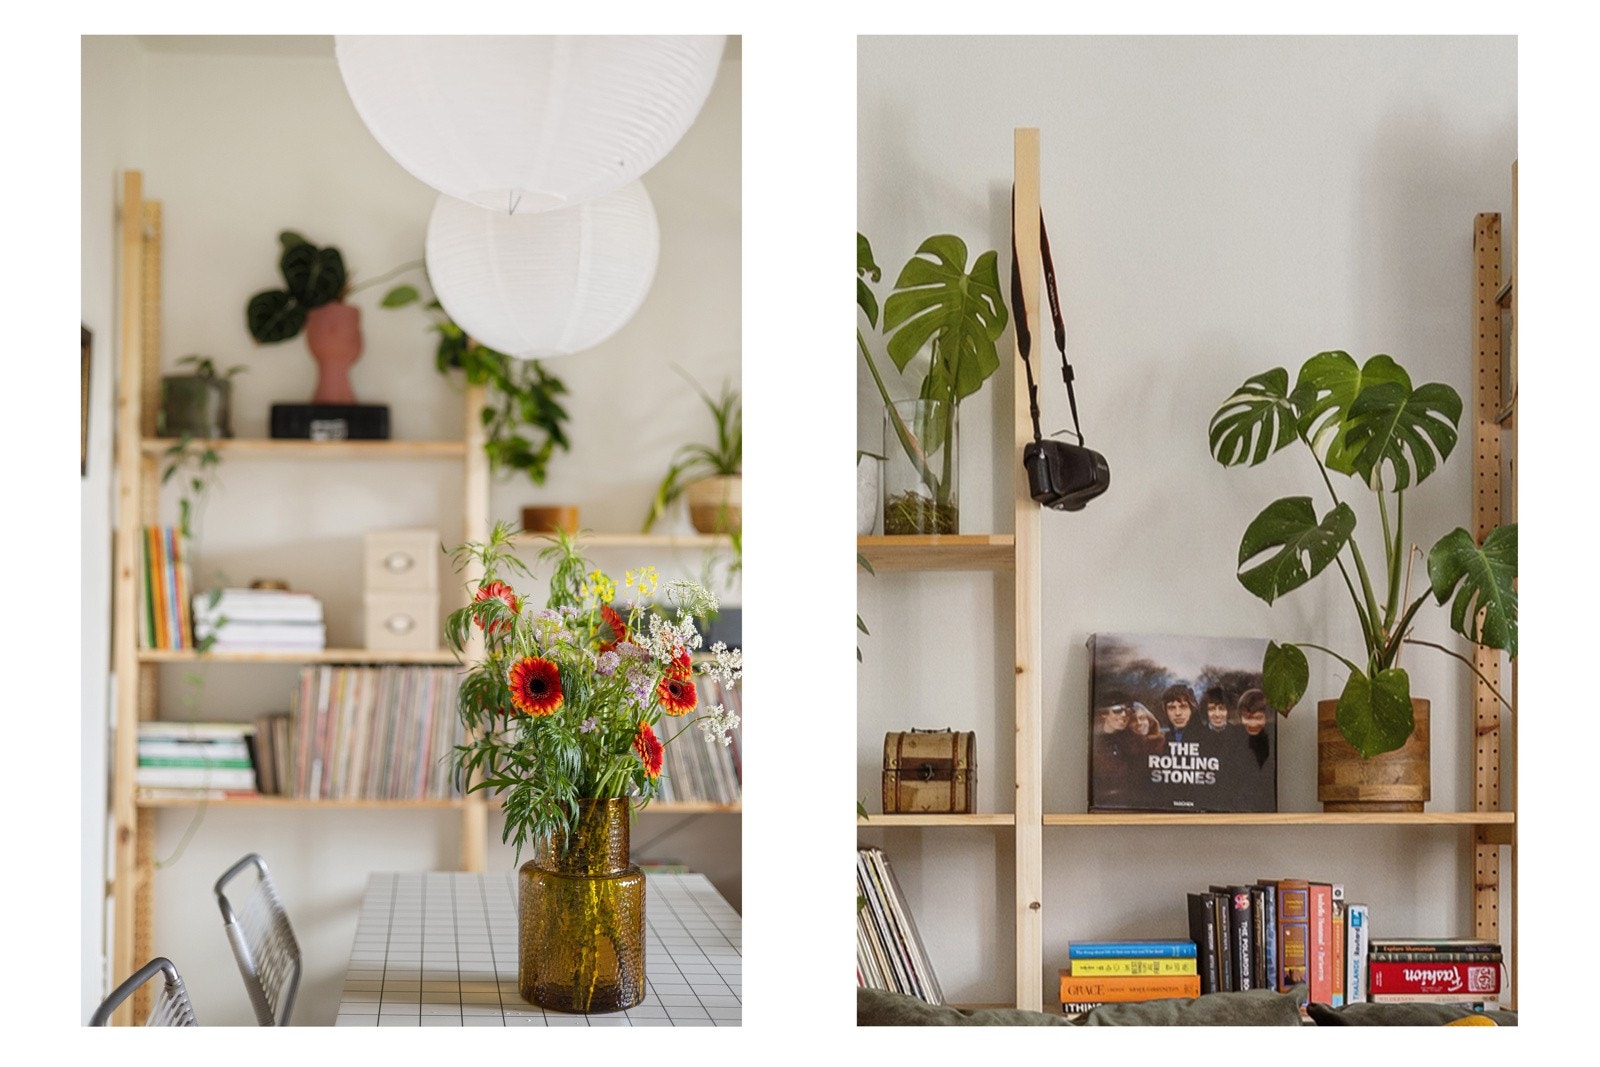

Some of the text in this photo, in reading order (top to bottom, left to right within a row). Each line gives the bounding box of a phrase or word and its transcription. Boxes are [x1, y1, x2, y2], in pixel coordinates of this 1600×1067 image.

[1168, 742, 1200, 756] THE
[1148, 755, 1219, 771] ROLLING
[1151, 770, 1216, 785] STONES
[1242, 938, 1250, 977] POLAROID
[1403, 966, 1463, 992] Fashion
[1479, 968, 1491, 990] 365
[1067, 984, 1105, 996] GRACE
